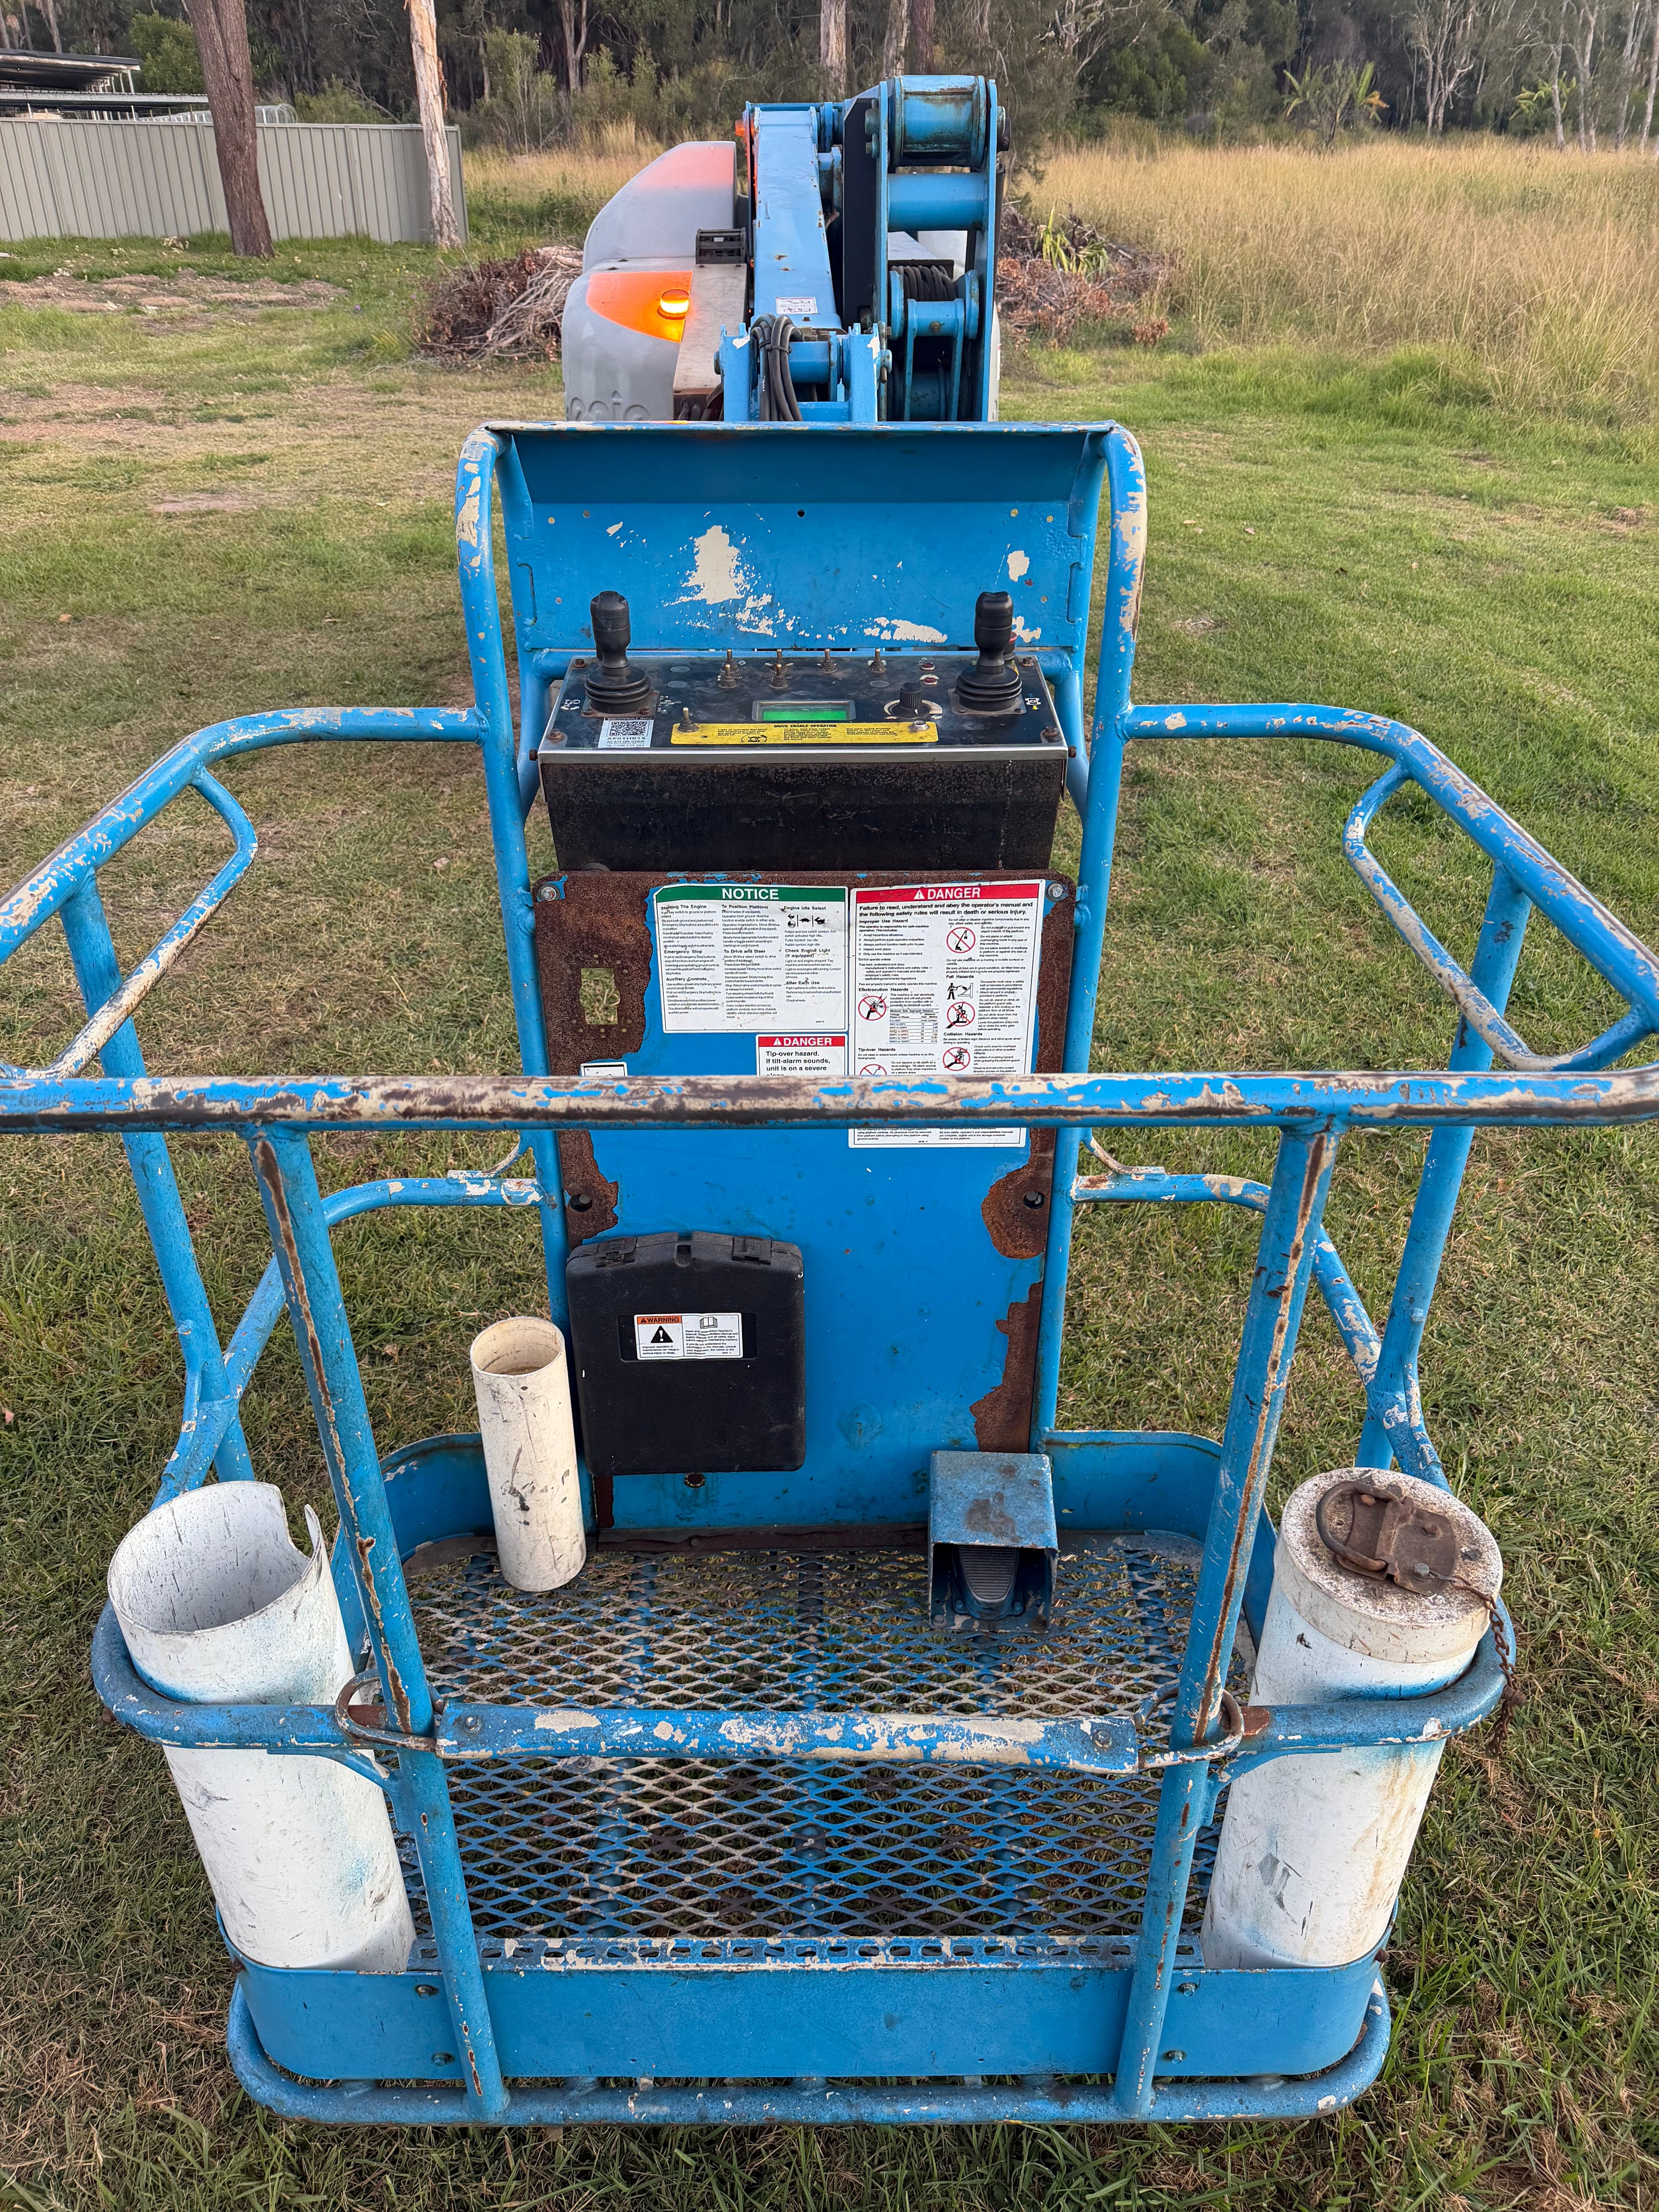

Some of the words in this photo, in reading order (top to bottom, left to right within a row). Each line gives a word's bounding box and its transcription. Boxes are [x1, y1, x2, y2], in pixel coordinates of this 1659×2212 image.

[722, 888, 779, 900] NOTICE
[927, 887, 981, 899] DANGER
[784, 1038, 832, 1046] DANGER
